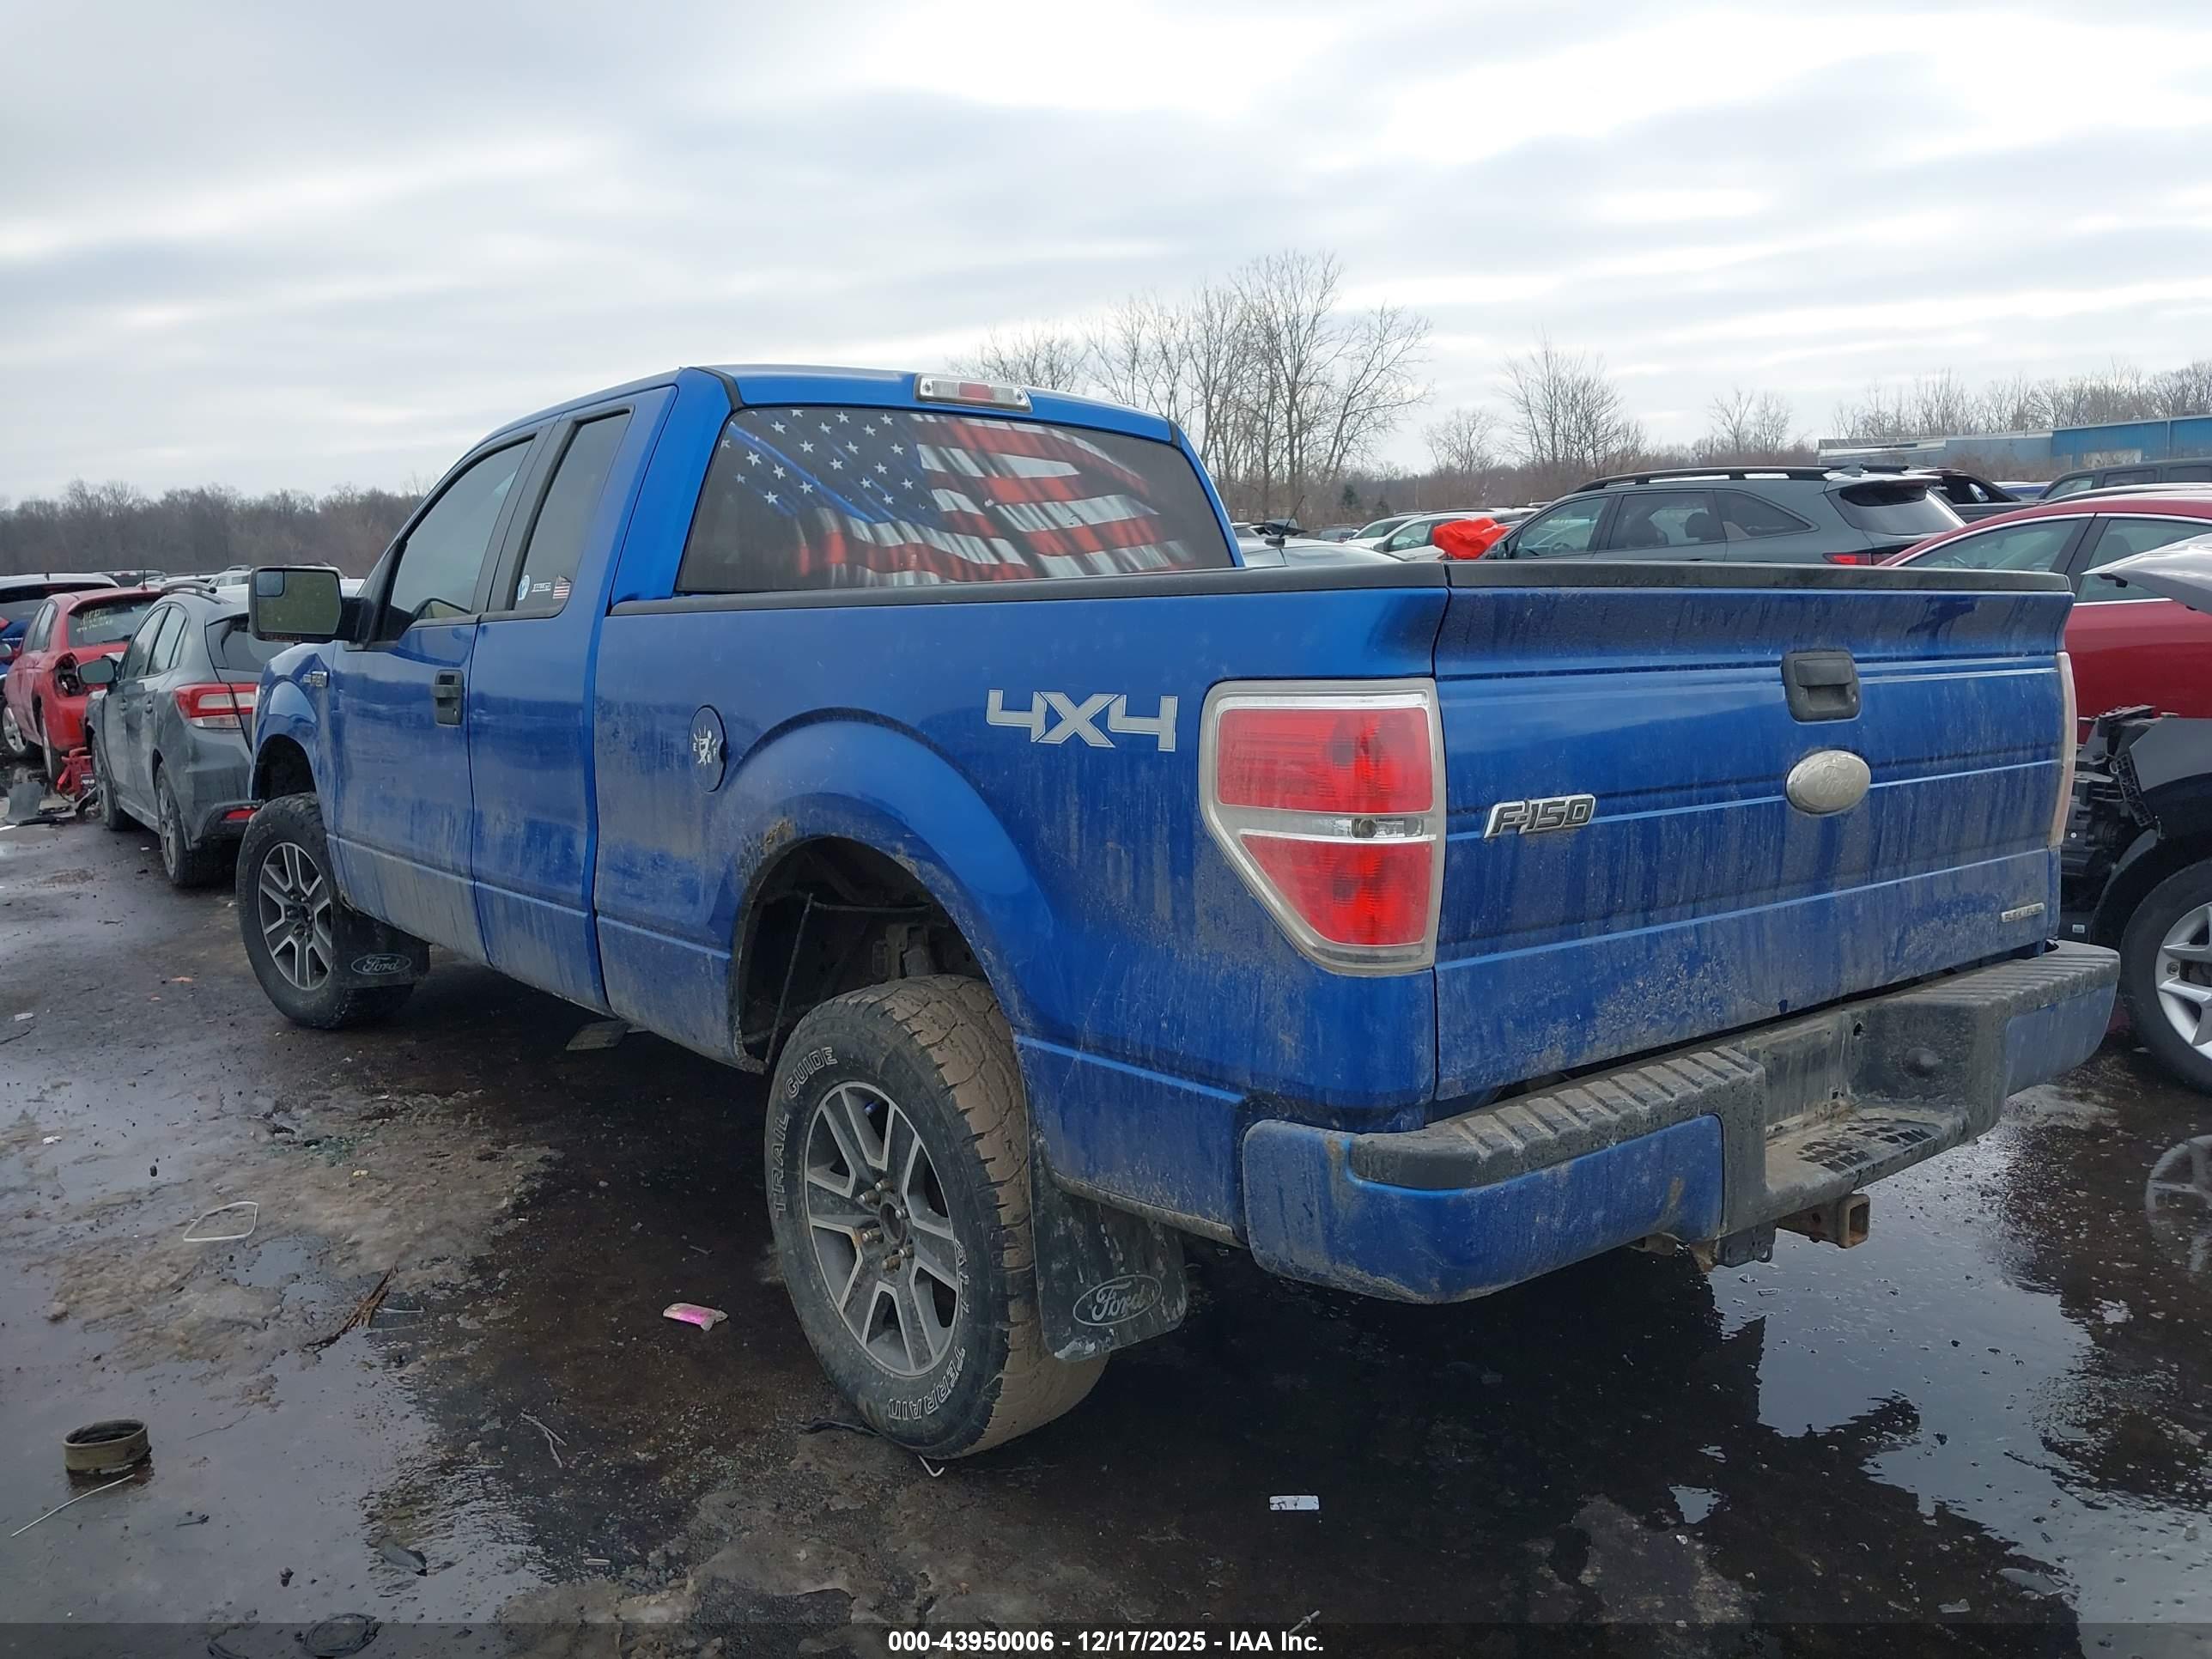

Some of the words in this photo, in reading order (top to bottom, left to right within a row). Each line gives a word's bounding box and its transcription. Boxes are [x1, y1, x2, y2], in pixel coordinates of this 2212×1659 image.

[1484, 793, 1596, 839] F-150
[362, 956, 400, 972] Ford
[772, 1113, 790, 1211] TRAIL
[786, 1047, 838, 1098] GUIDE
[954, 1238, 970, 1319] ALL
[1091, 1280, 1146, 1322] Ford
[888, 1346, 967, 1421] TERRAIN
